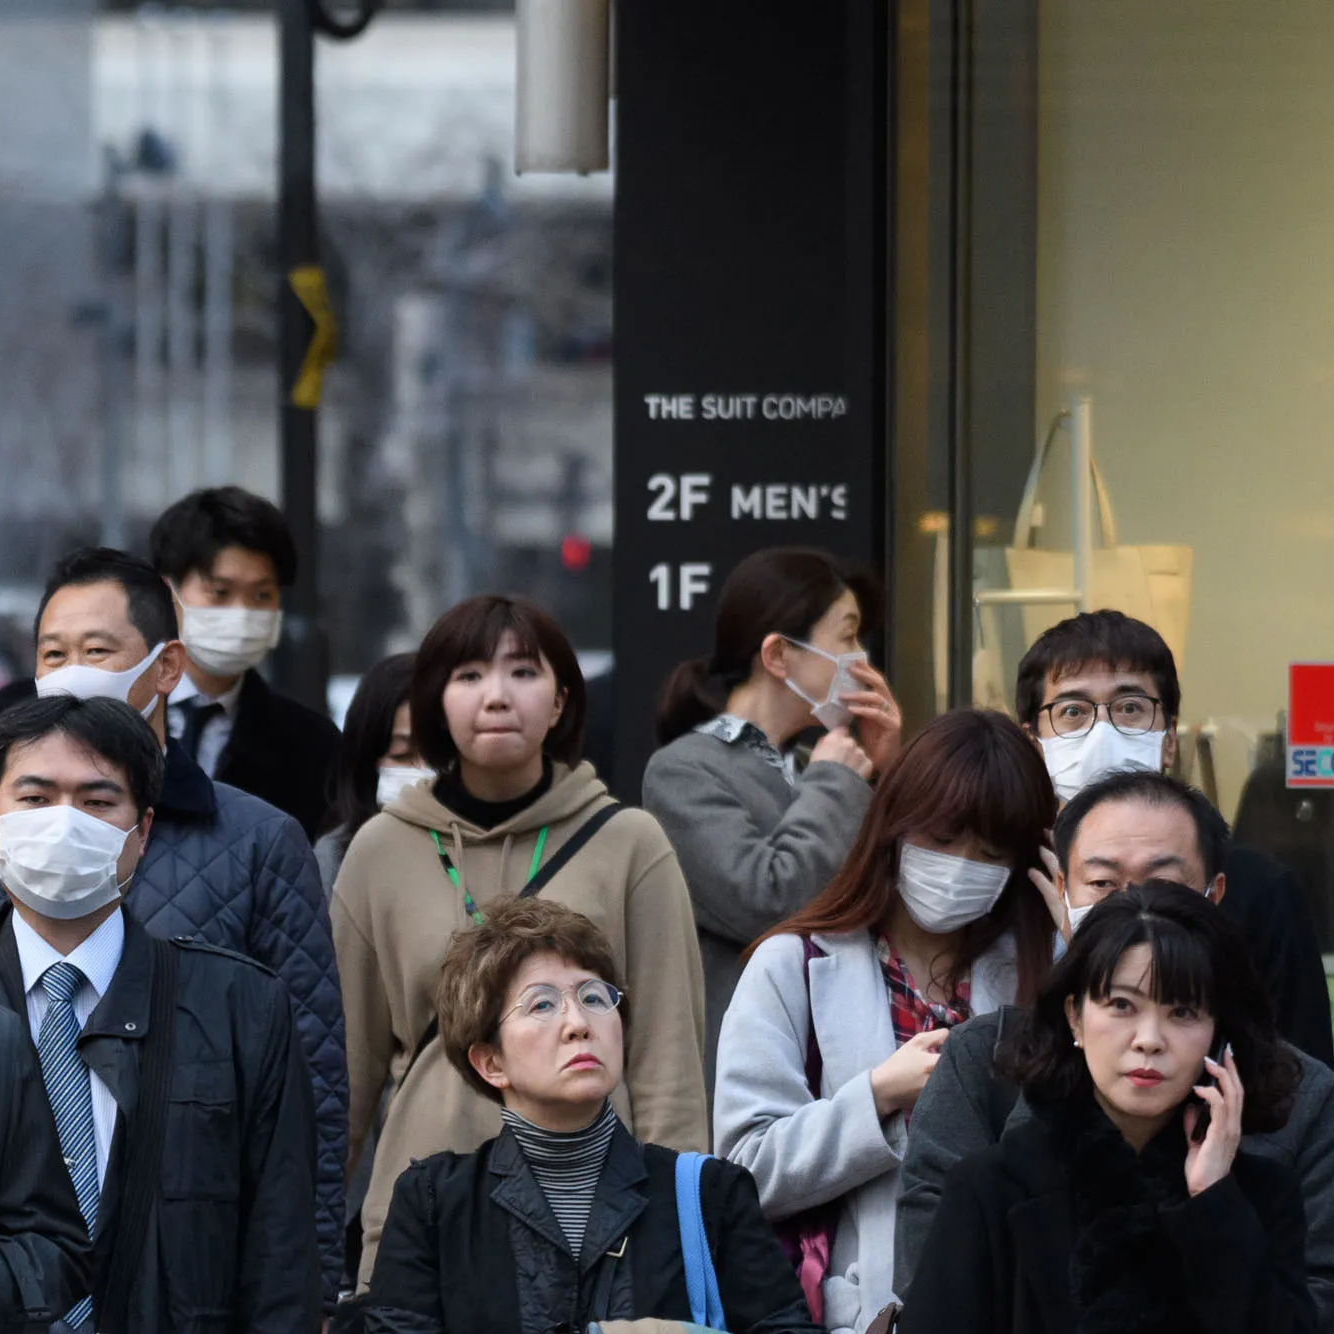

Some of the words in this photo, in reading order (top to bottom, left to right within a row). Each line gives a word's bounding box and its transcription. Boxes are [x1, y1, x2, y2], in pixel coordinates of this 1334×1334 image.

[644, 394, 694, 420] THE
[701, 394, 757, 420] SUIT
[762, 394, 846, 420] COMPA
[646, 473, 712, 522] 2F
[648, 562, 712, 611] 1F
